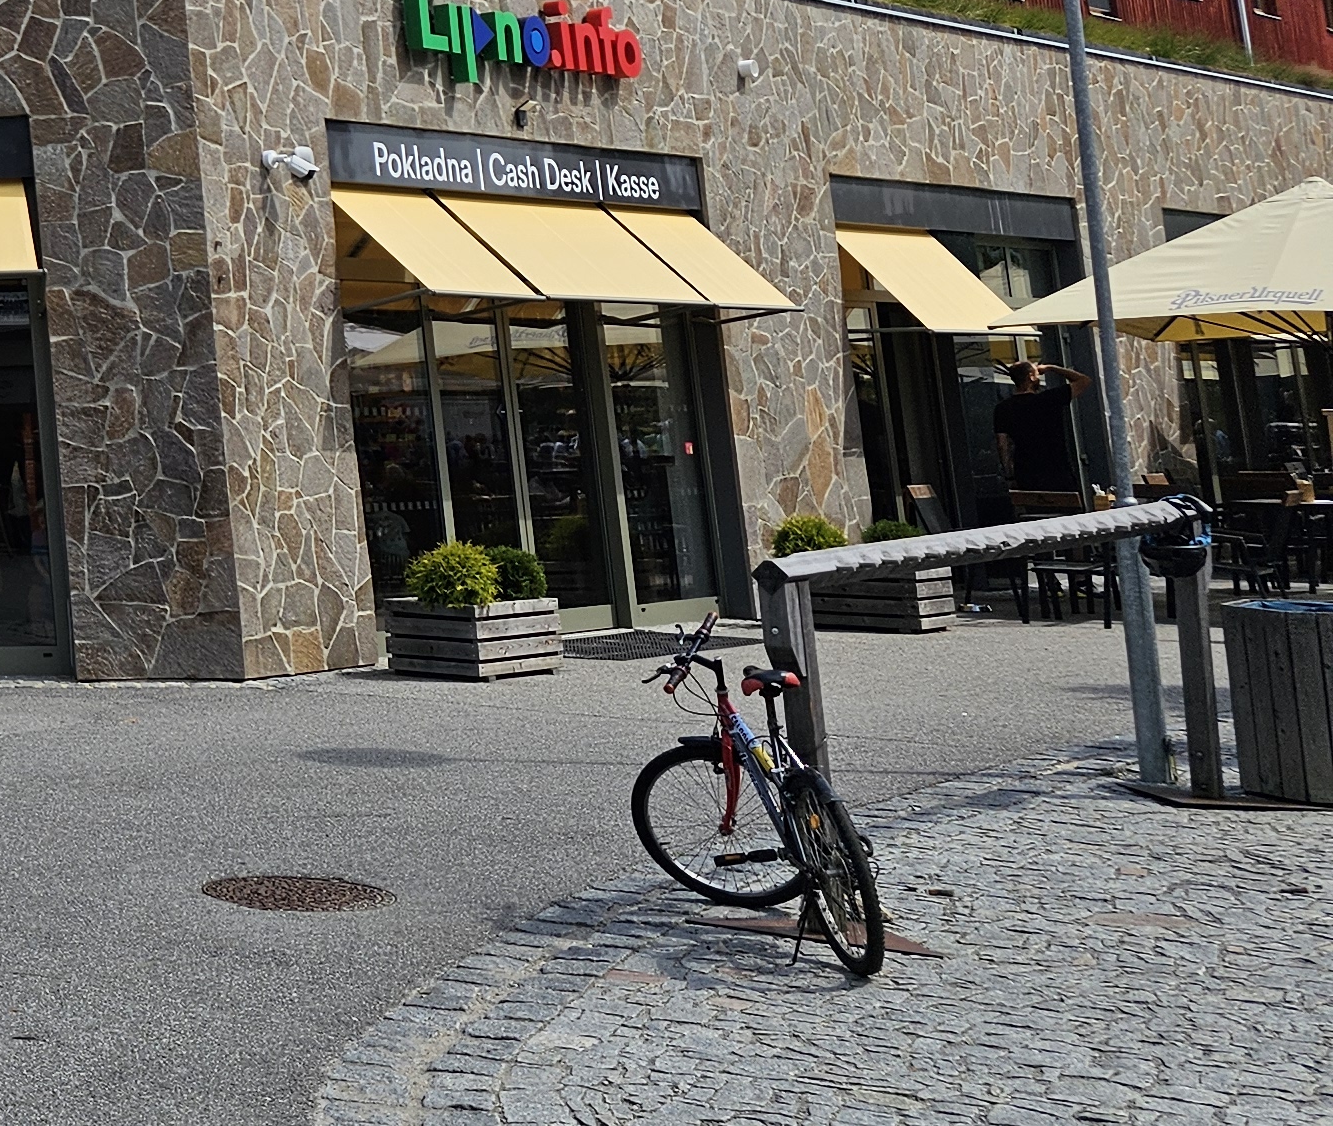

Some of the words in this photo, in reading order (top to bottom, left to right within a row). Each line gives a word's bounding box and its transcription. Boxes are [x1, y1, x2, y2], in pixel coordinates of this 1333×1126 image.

[372, 141, 474, 186] Pokladna
[488, 151, 541, 190] Cash
[543, 157, 593, 195] Desk
[606, 164, 661, 201] Kasse
[1168, 288, 1252, 311] Pilsner
[1250, 286, 1325, 305] Urquell
